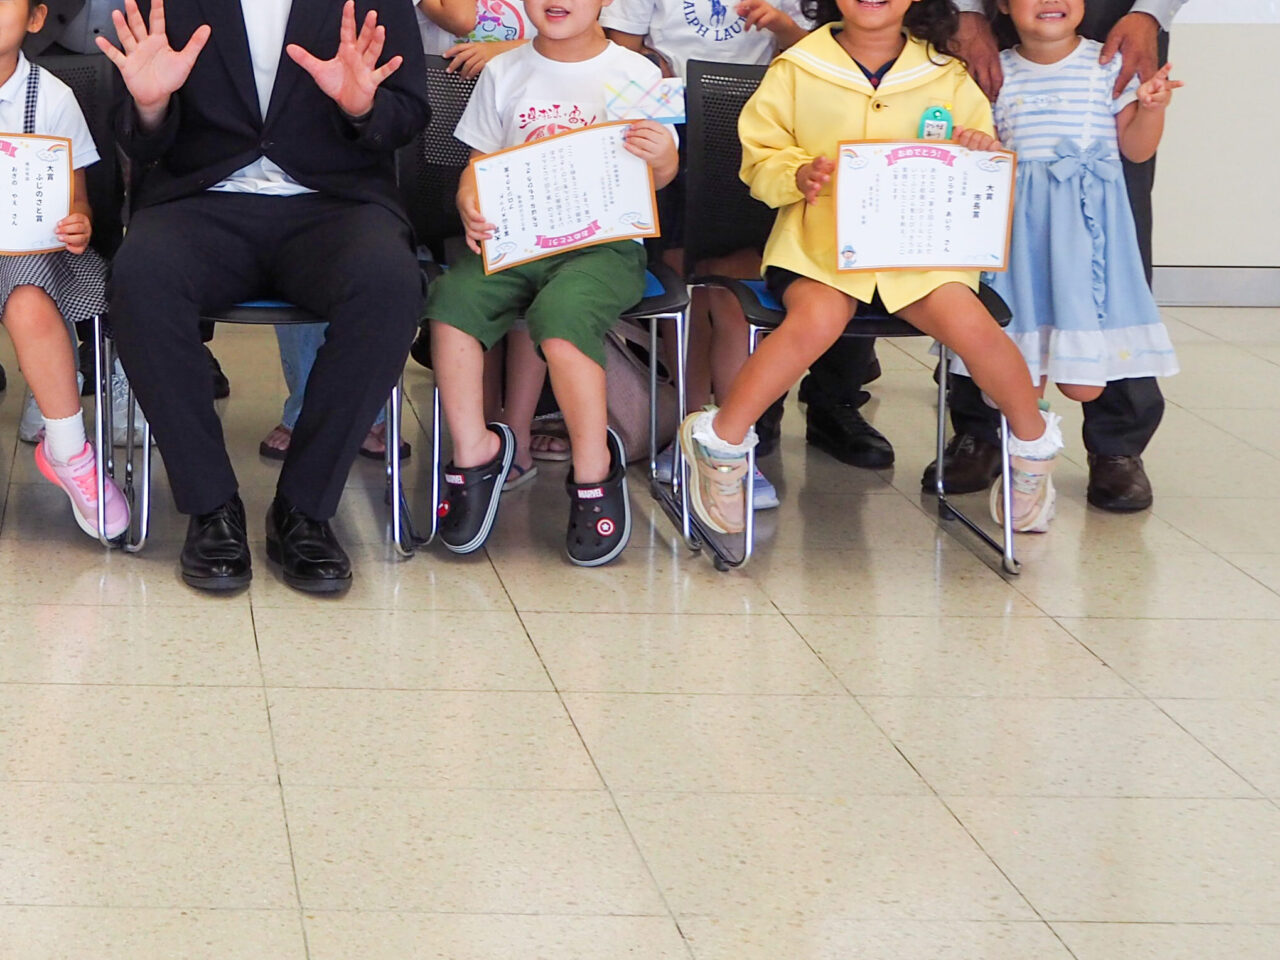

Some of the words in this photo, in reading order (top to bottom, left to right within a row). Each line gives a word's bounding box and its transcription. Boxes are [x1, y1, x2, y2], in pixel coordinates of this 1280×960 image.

[47, 165, 54, 181] 大賞
[35, 173, 44, 223] ふじのさと賞
